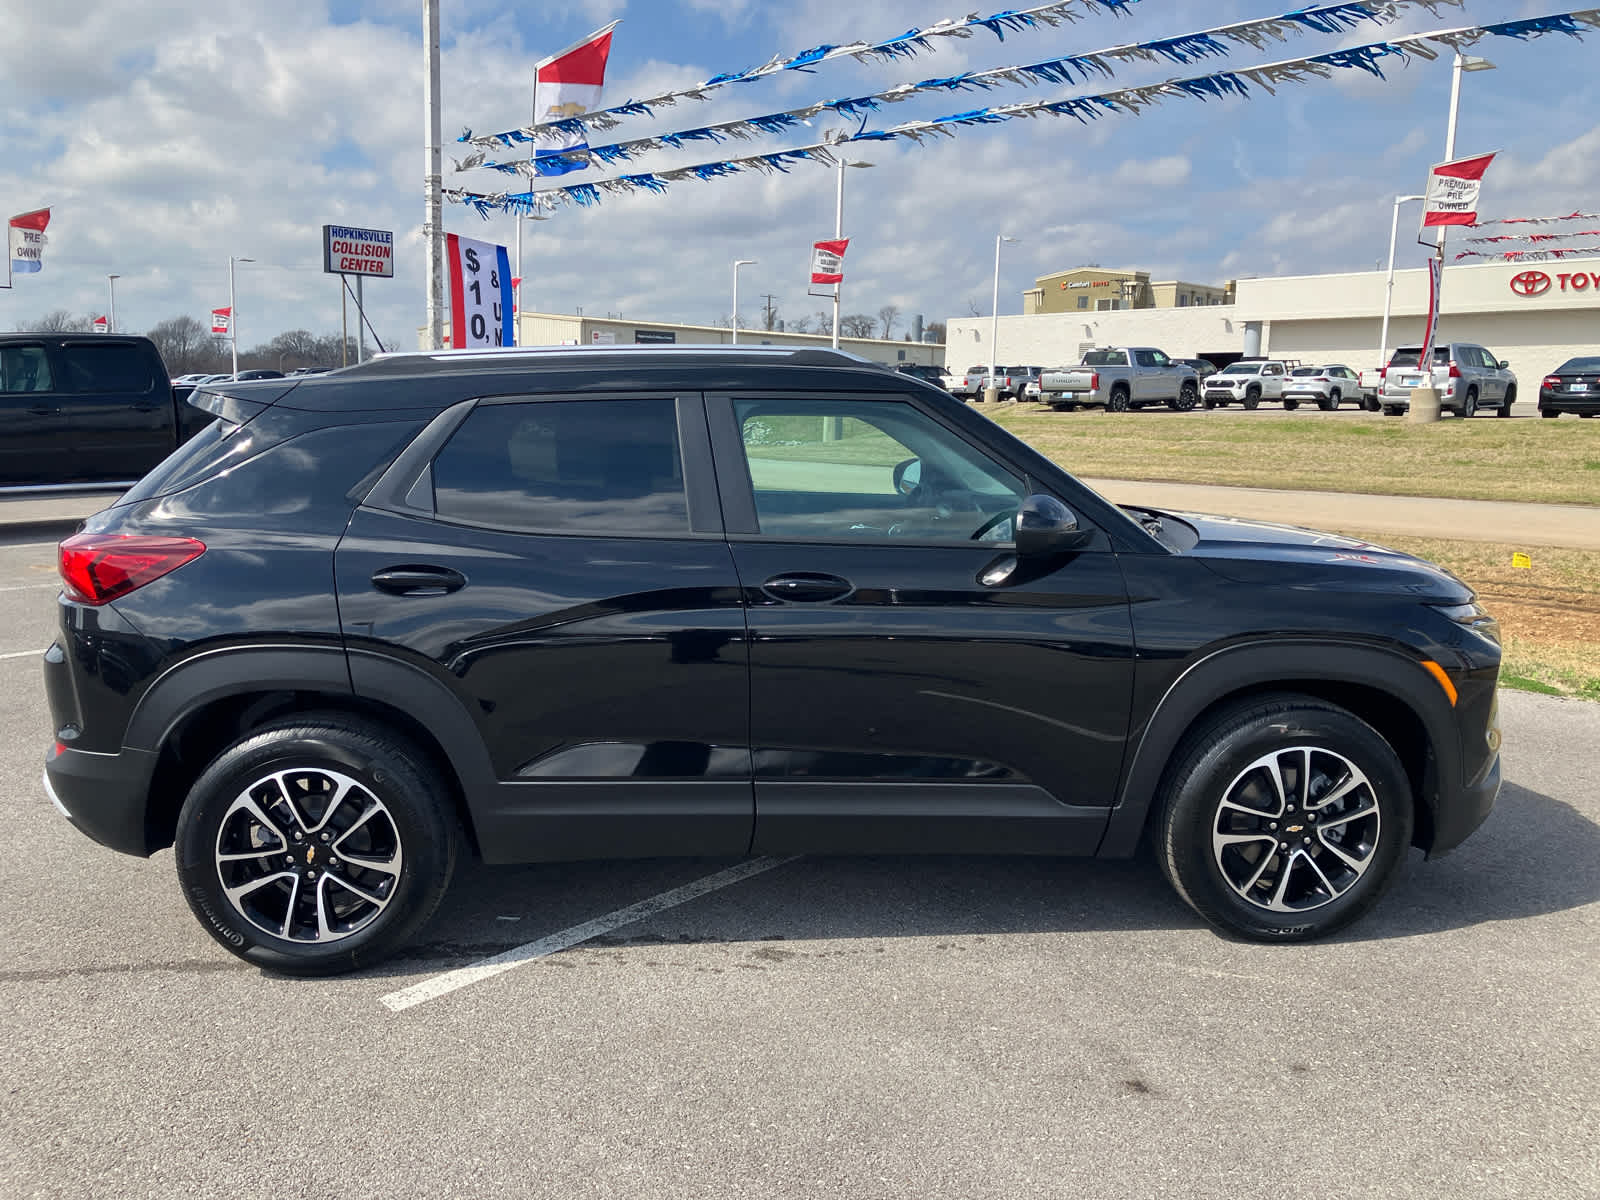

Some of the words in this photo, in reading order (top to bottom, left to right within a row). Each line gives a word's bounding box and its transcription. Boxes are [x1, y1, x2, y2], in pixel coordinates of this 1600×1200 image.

[1447, 191, 1463, 200] PRE
[1438, 202, 1469, 210] OWNED
[23, 231, 41, 243] PRE
[331, 227, 391, 244] HOPKINSVILLE
[332, 240, 391, 259] COLLISION
[340, 256, 384, 273] CENTER
[491, 269, 500, 289] &
